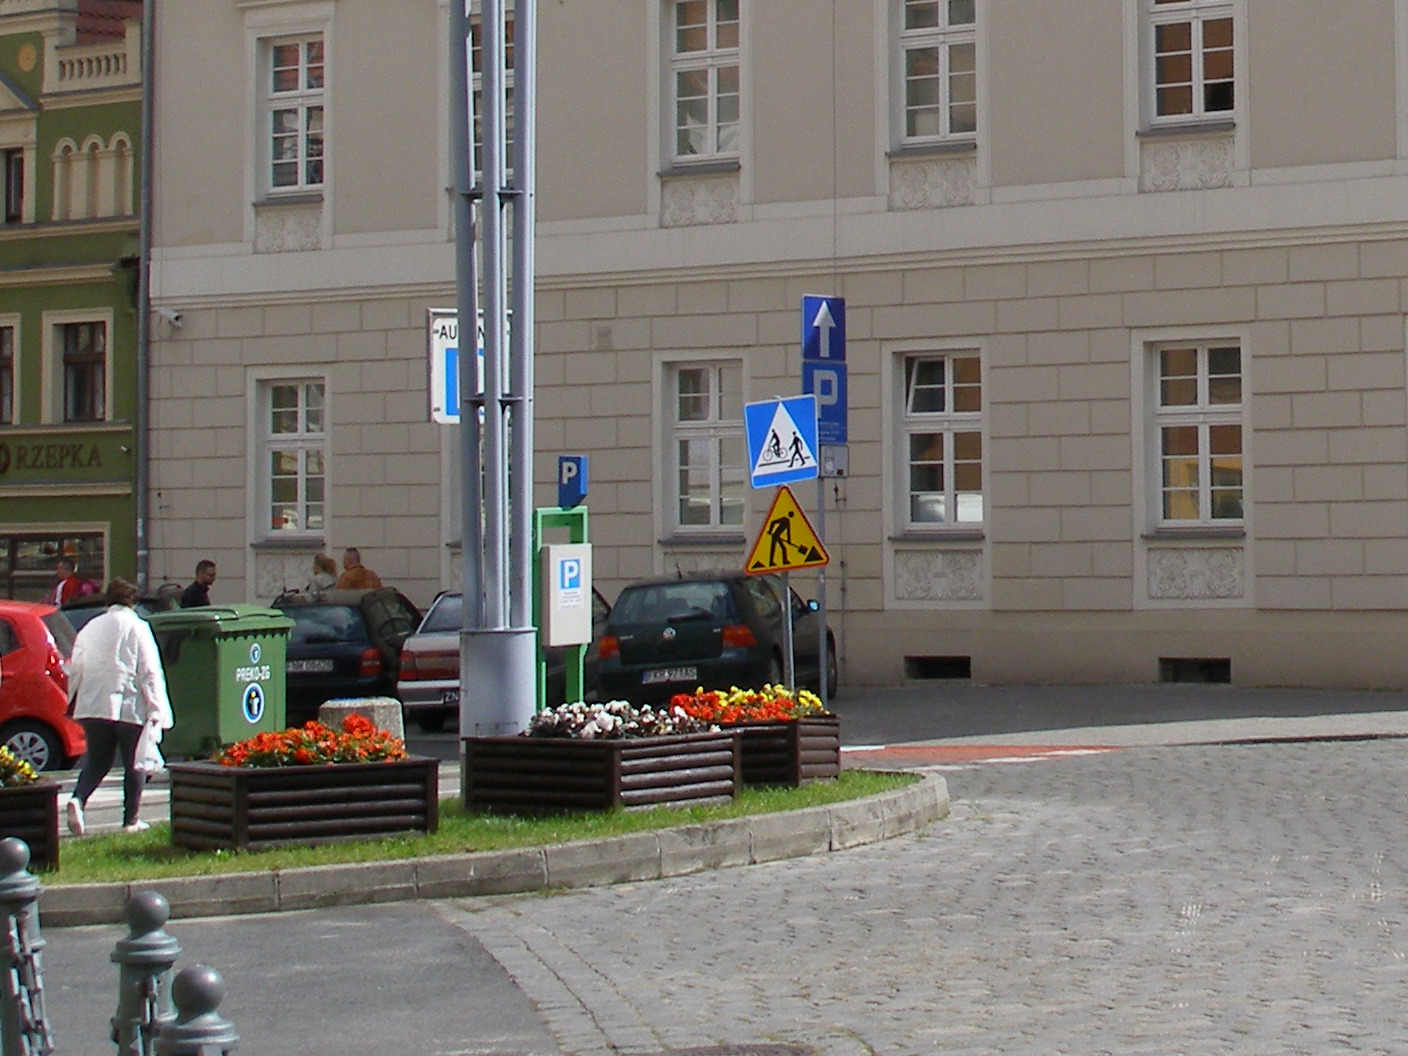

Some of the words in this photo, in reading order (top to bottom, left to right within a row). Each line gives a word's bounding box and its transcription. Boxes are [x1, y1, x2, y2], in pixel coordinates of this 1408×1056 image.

[813, 369, 838, 419] P
[15, 444, 102, 469] RZEPKA
[562, 461, 578, 485] P
[564, 561, 579, 588] P
